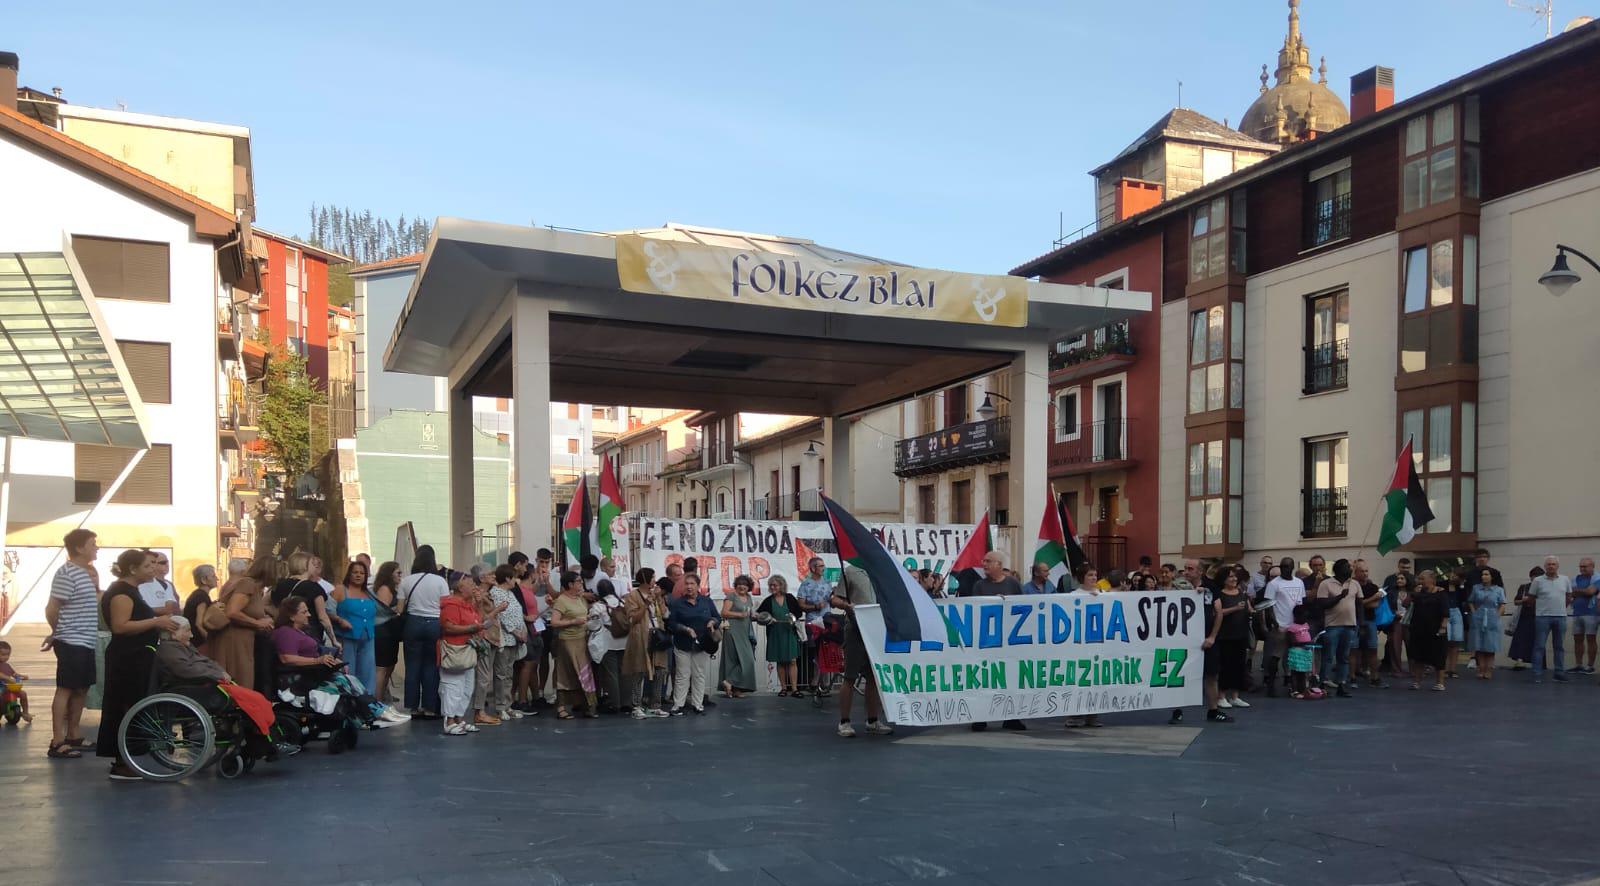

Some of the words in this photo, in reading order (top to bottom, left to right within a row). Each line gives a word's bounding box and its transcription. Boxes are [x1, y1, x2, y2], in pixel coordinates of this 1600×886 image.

[1136, 596, 1197, 642] STOP
[1149, 648, 1188, 688] EZ
[896, 697, 973, 724] ERMUA
